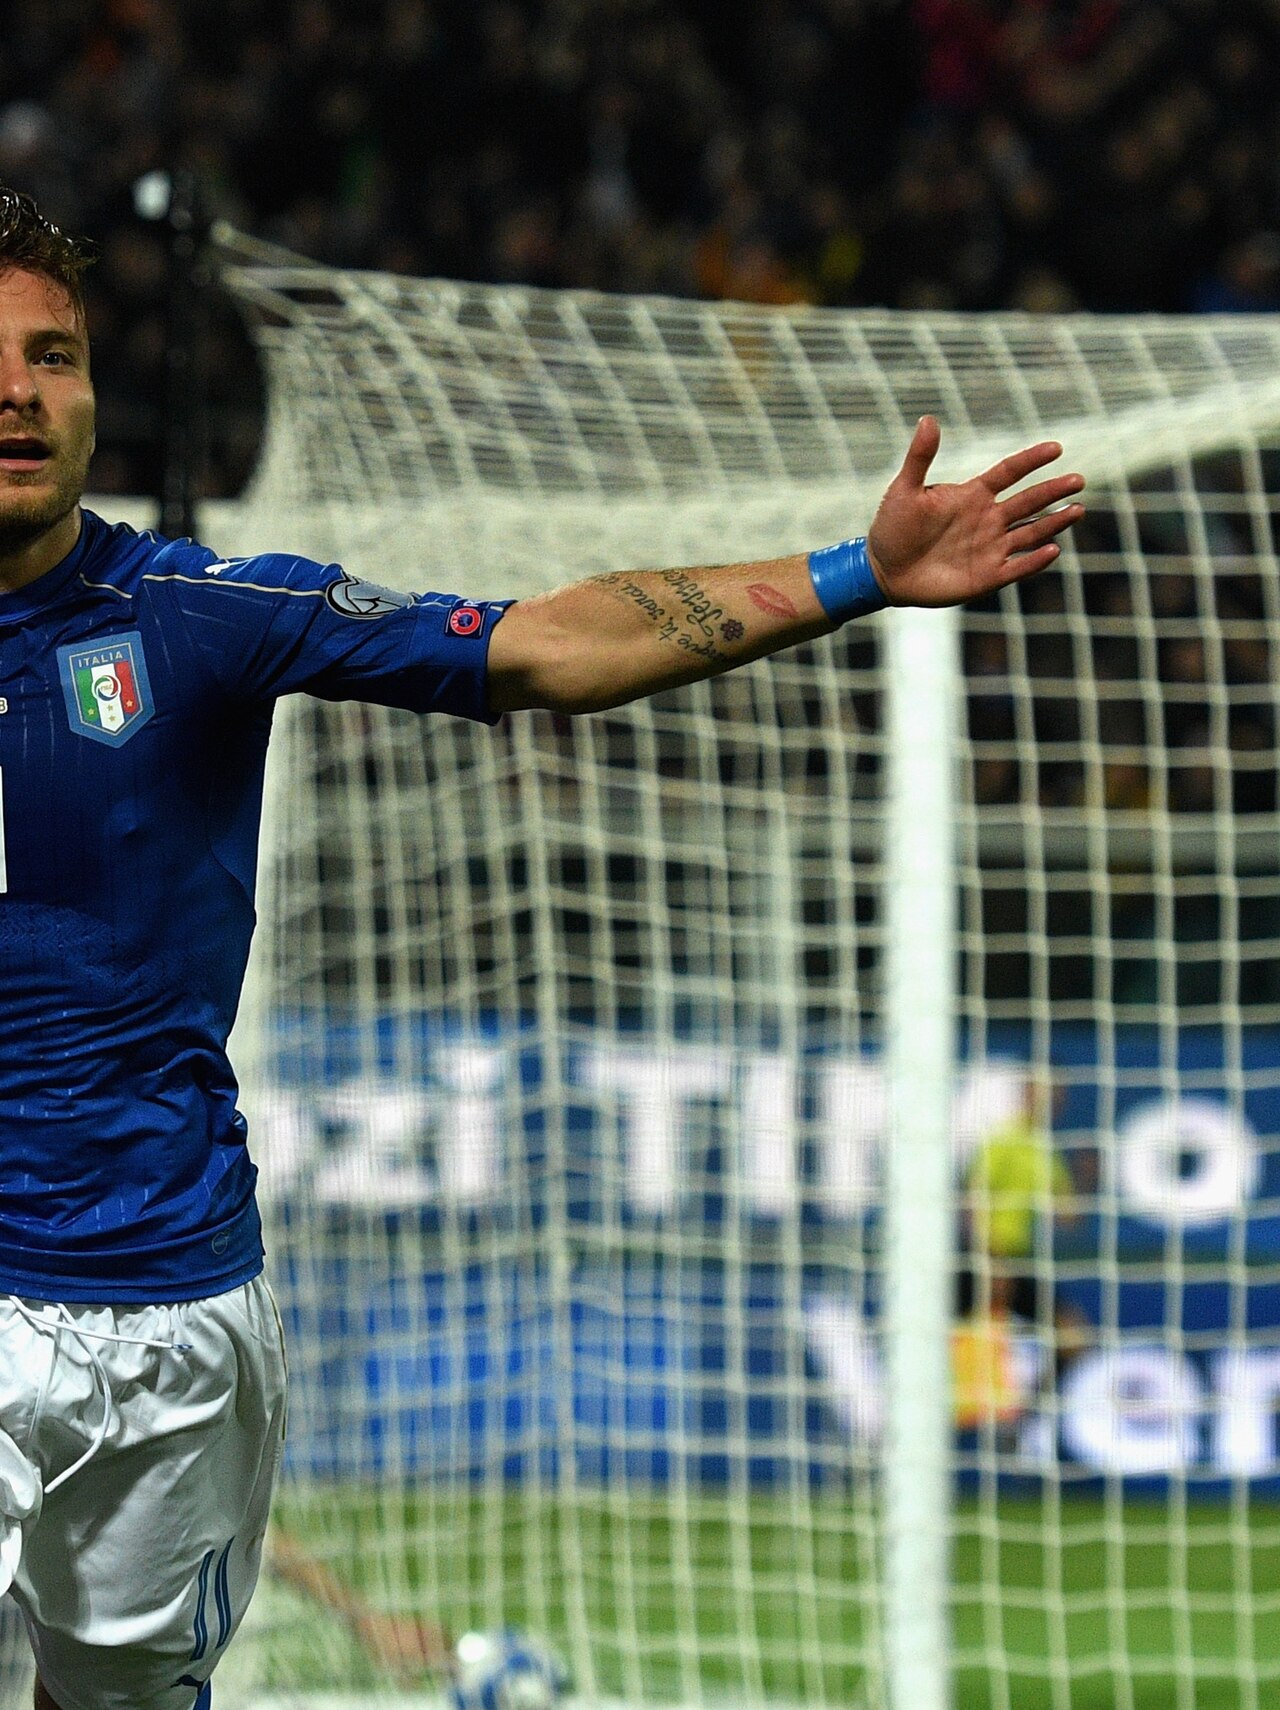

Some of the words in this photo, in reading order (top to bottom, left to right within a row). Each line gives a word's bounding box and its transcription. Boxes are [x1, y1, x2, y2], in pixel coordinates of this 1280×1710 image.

[78, 650, 124, 668] ITALIA
[1115, 1095, 1260, 1232] o
[189, 1534, 233, 1663] 11
